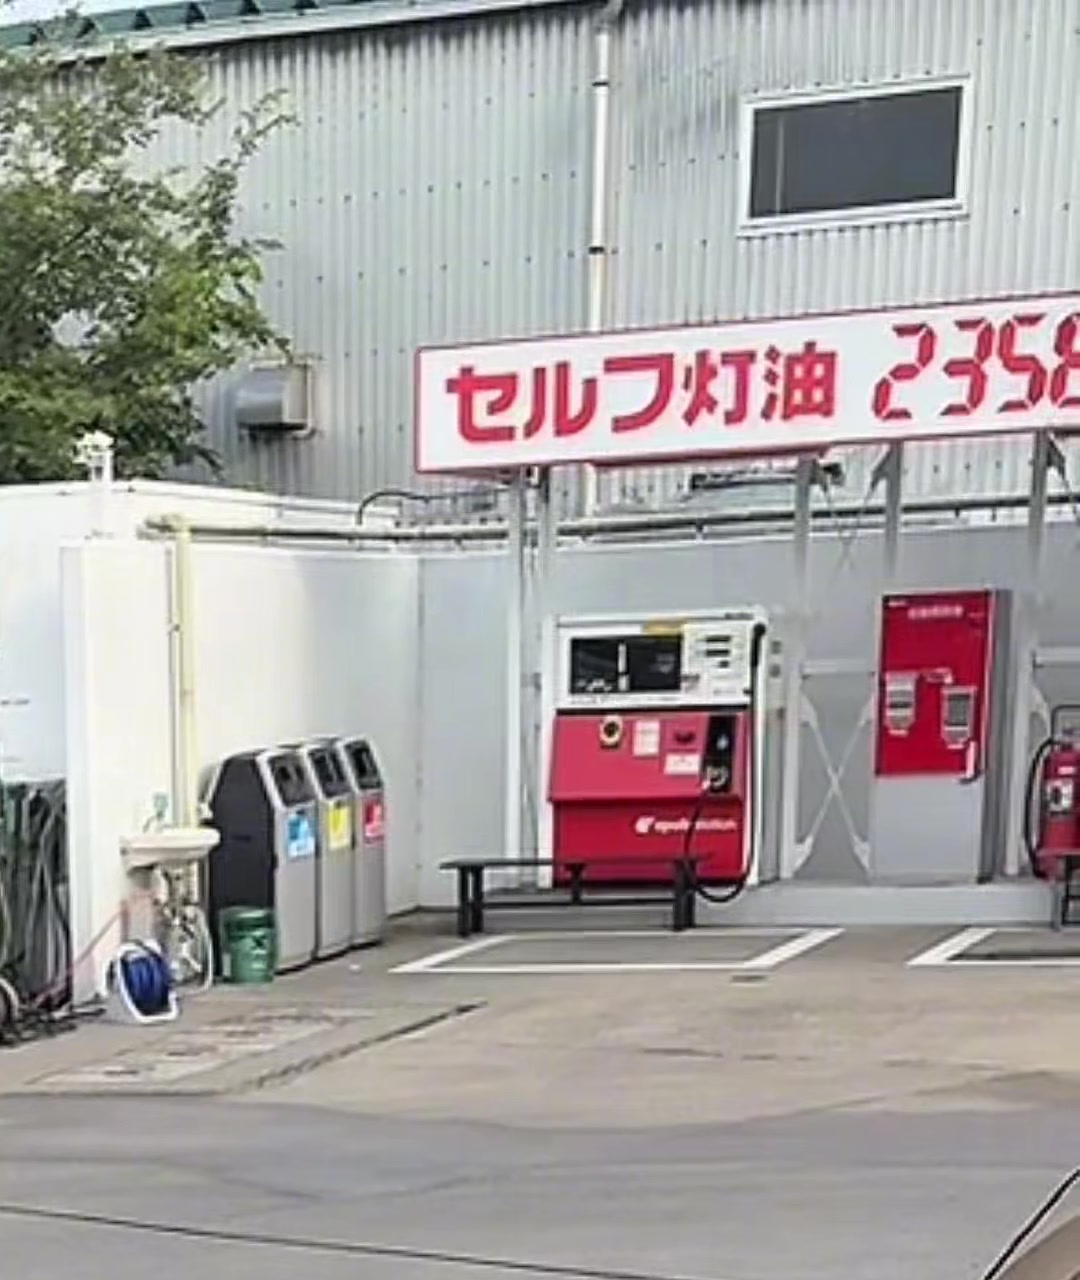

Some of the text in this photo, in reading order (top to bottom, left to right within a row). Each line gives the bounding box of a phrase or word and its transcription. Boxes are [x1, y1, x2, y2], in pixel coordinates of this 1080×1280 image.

[445, 312, 1080, 444] セルフ灯油 2358
